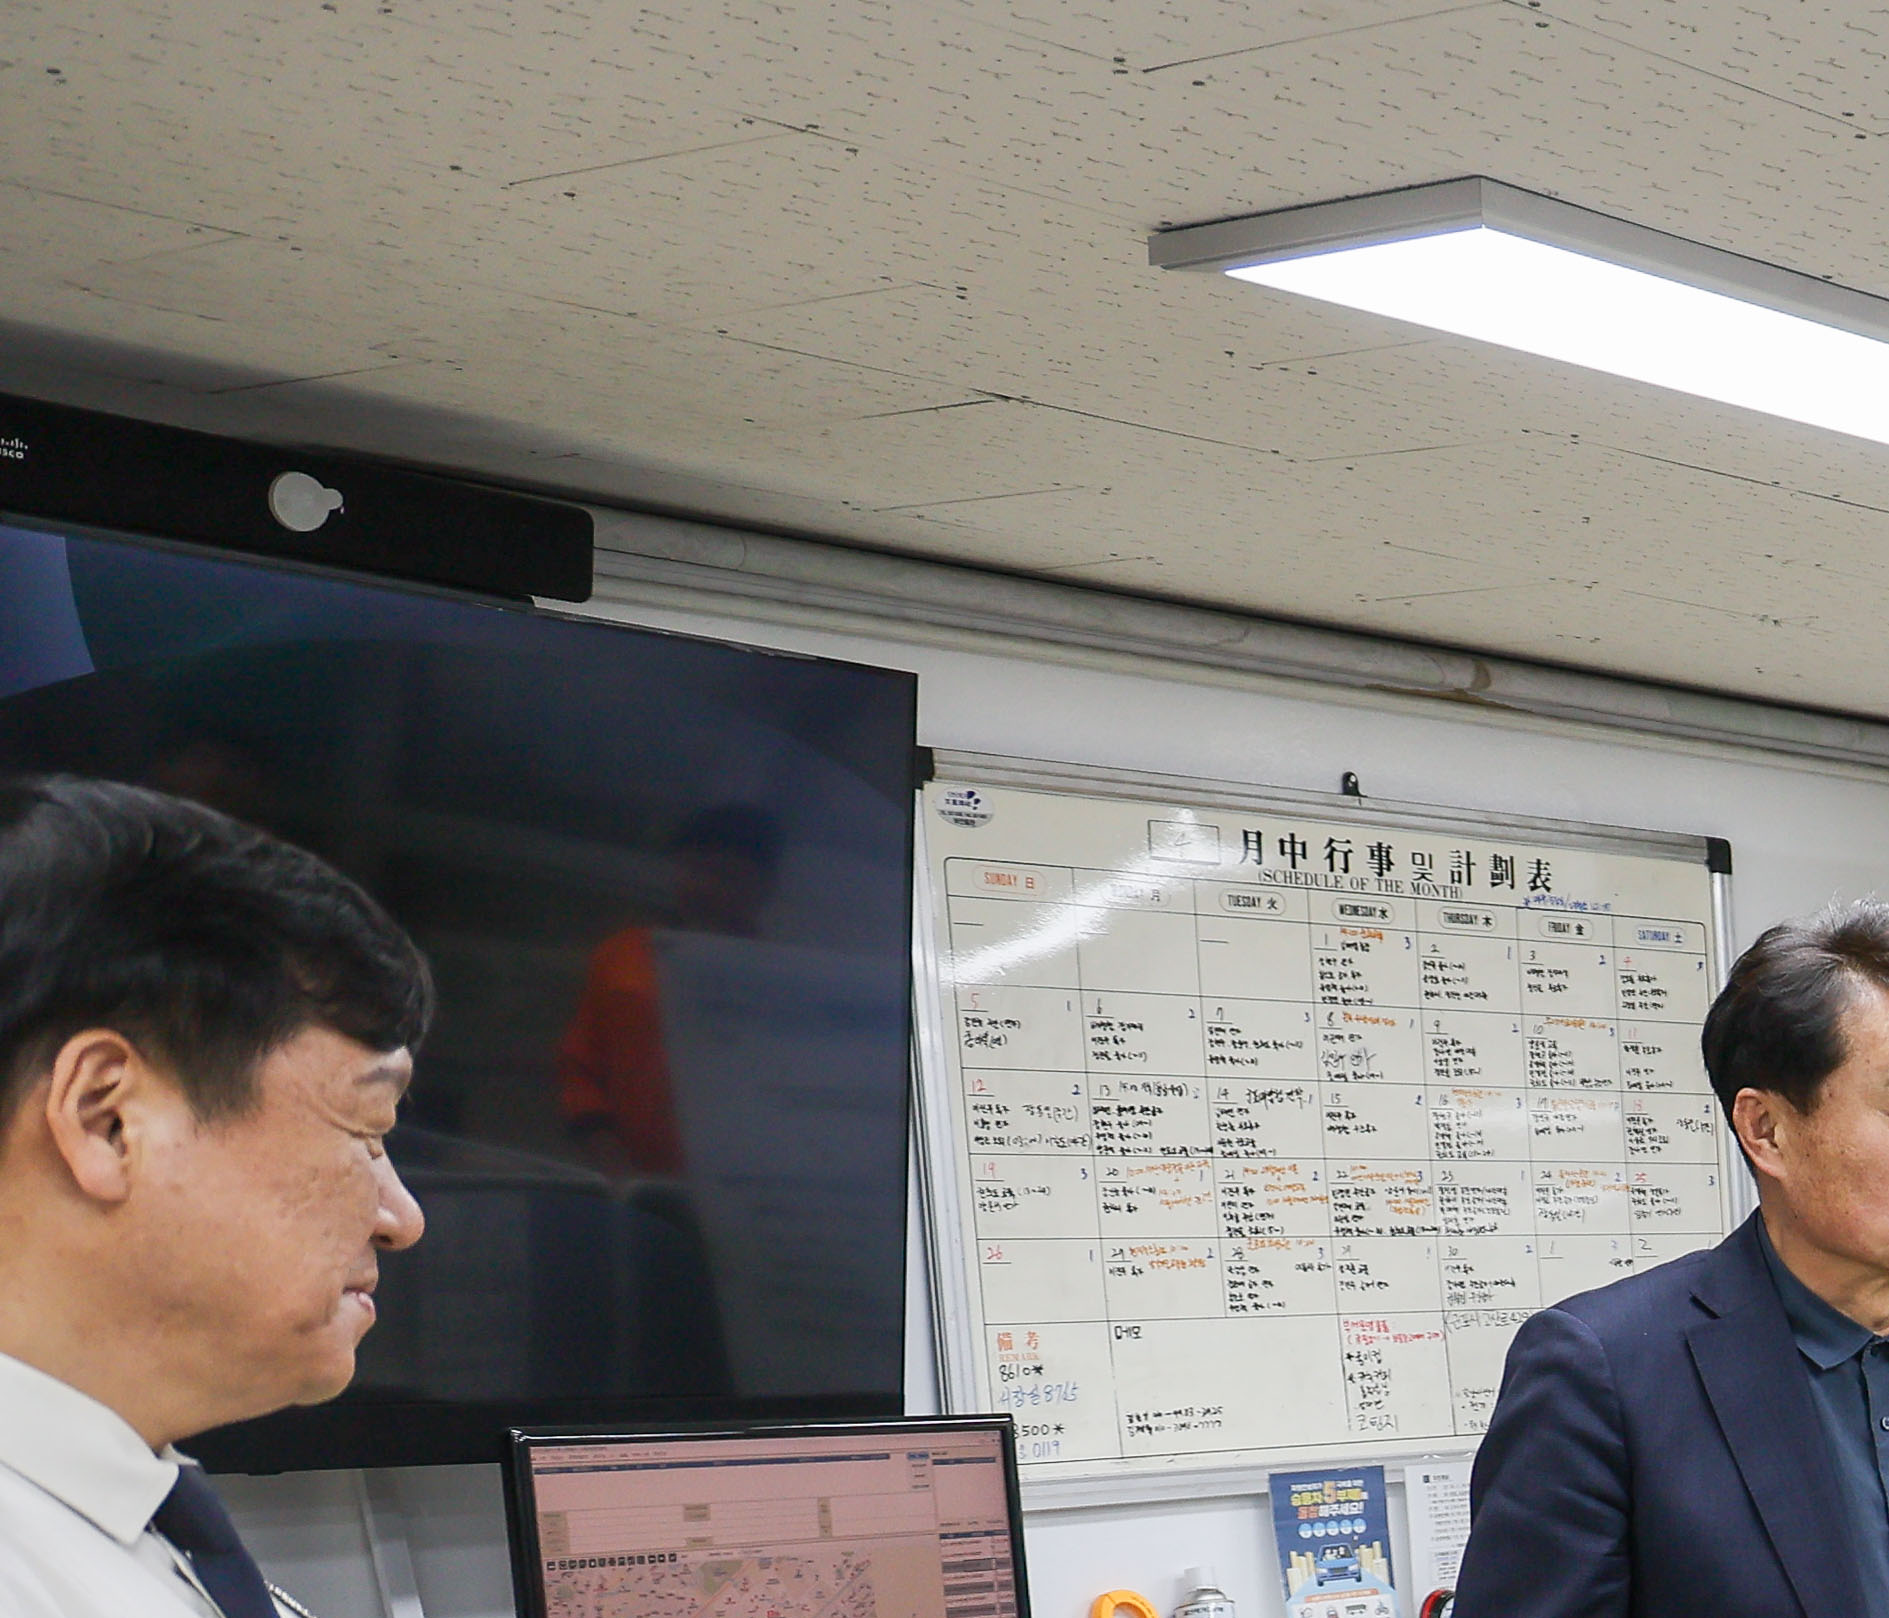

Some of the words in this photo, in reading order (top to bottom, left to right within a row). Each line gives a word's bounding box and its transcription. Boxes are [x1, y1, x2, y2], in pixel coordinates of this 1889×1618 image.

[1411, 852, 1434, 882] 및
[1448, 849, 1553, 893] 計劃表
[984, 872, 1018, 888] SUNDAY
[1350, 876, 1368, 890] OF
[1376, 879, 1404, 894] THE
[1228, 894, 1261, 907] TUESDAY
[1339, 904, 1376, 917] WEDNESDAY
[1443, 912, 1478, 925] THURSDAY
[1548, 921, 1570, 933] FRIDAY
[1638, 929, 1670, 941] SATURDAY
[1114, 1326, 1143, 1340] 메모
